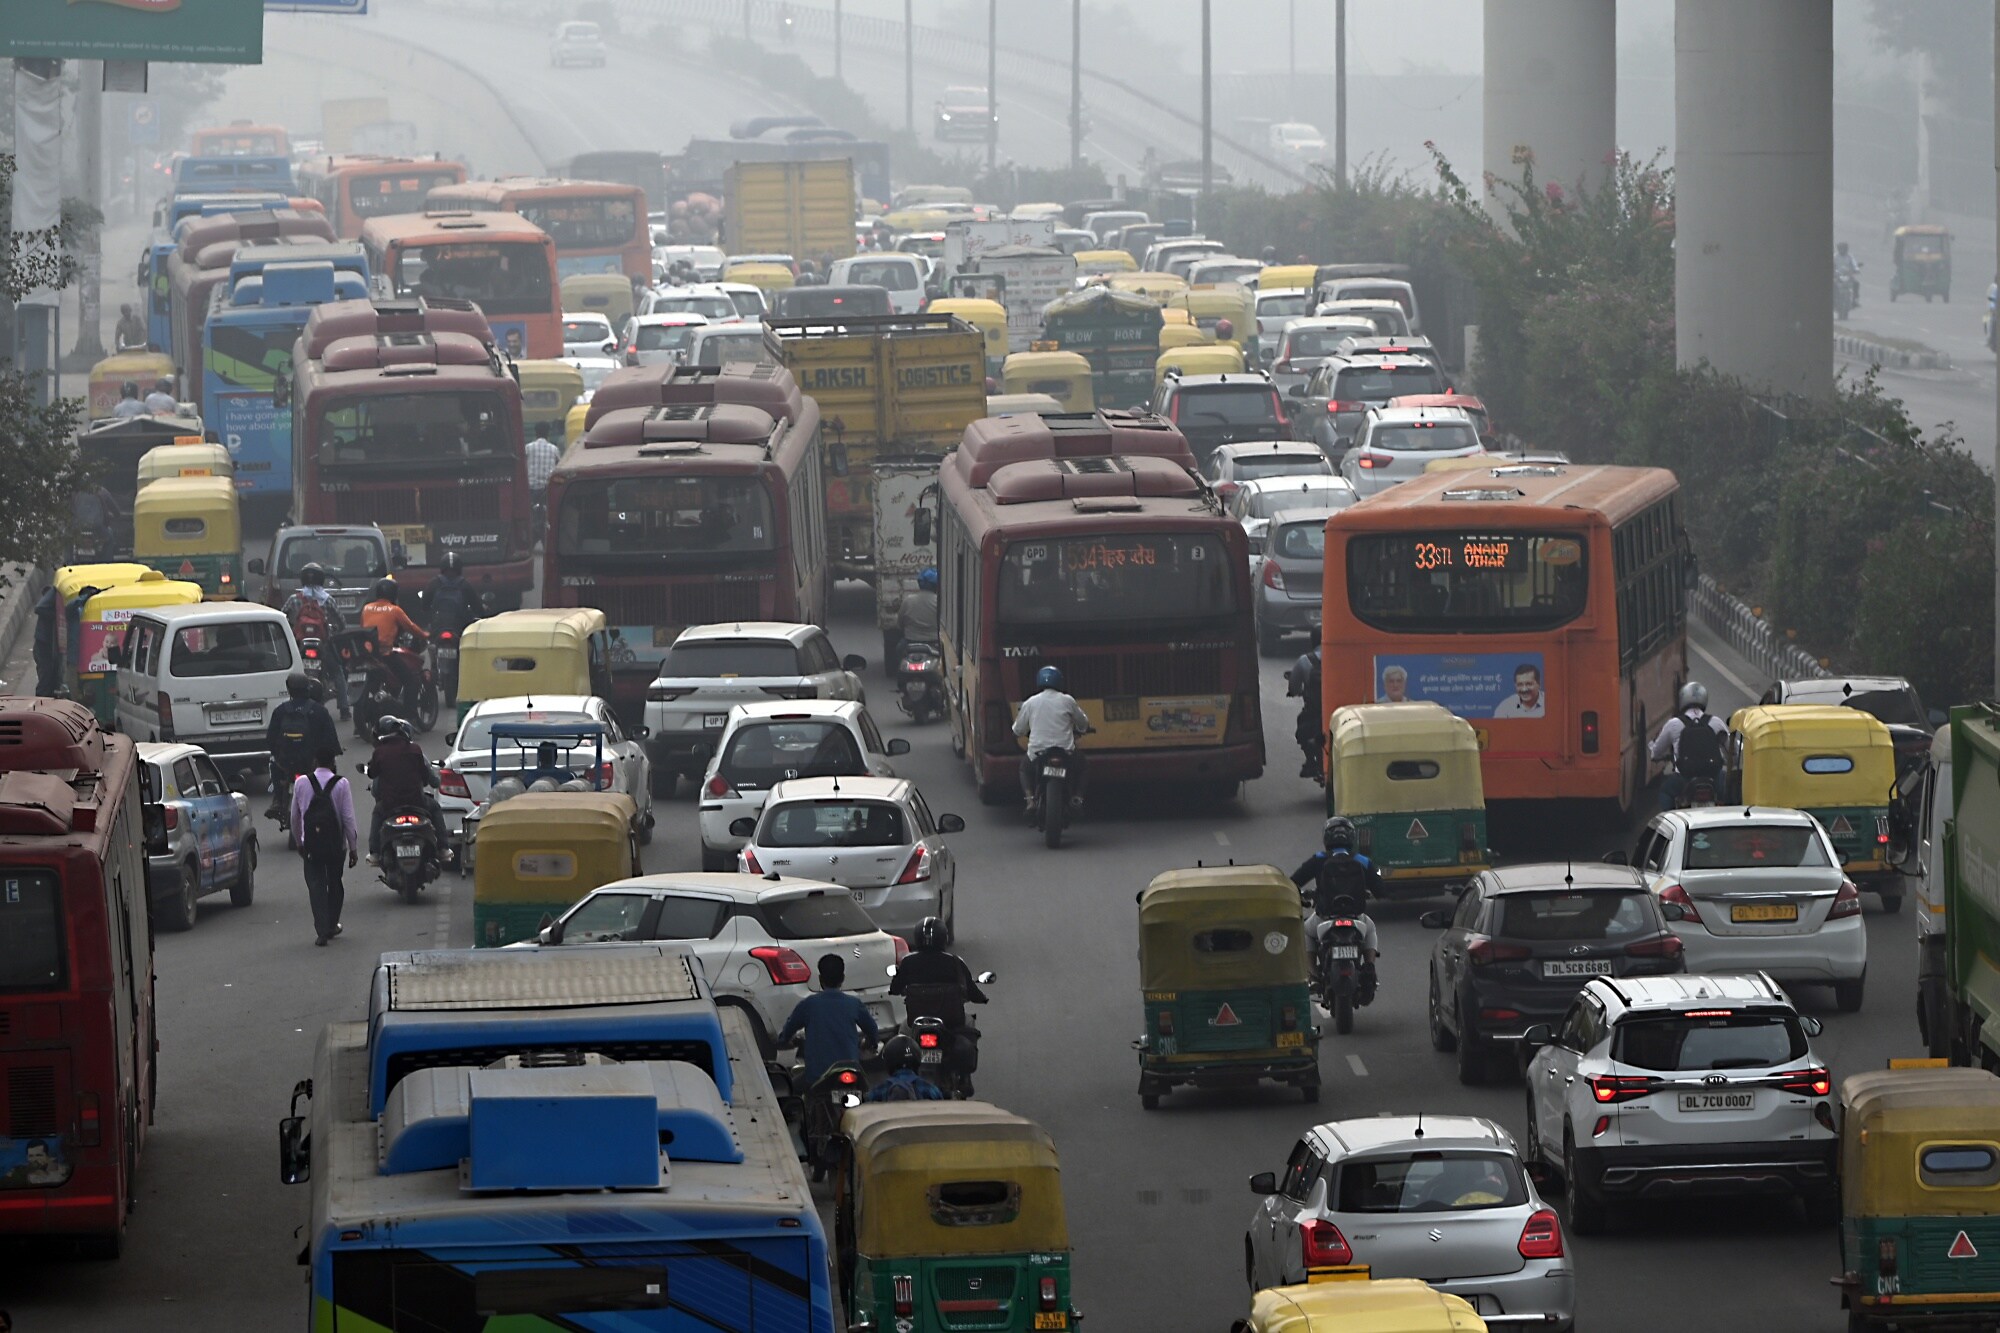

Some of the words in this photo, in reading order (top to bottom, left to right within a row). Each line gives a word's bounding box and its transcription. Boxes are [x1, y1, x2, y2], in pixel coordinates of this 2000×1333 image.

[1065, 331, 1092, 343] BLOW
[1114, 329, 1142, 340] HORN
[801, 366, 866, 388] LAKSH
[897, 364, 972, 388] LOGISTICS
[230, 412, 253, 420] have
[255, 412, 279, 422] gone
[226, 423, 247, 431] how
[249, 422, 276, 431] about
[319, 483, 351, 492] TATA
[440, 533, 468, 546] vijay
[470, 533, 498, 543] sales
[1026, 548, 1045, 559] GPD
[1463, 543, 1509, 555] ANAND
[899, 552, 934, 564] Horn
[1464, 555, 1505, 568] VIHAR
[561, 576, 596, 585] TATA
[1002, 646, 1040, 657] TATA
[90, 663, 108, 672] Call
[1552, 964, 1564, 974] DL
[1565, 963, 1584, 974] 5CR
[1585, 962, 1609, 973] 6689
[1686, 1096, 1700, 1108] DL
[1702, 1096, 1723, 1107] 7CU
[1725, 1095, 1752, 1107] 0007
[1877, 1275, 1900, 1294] CNG
